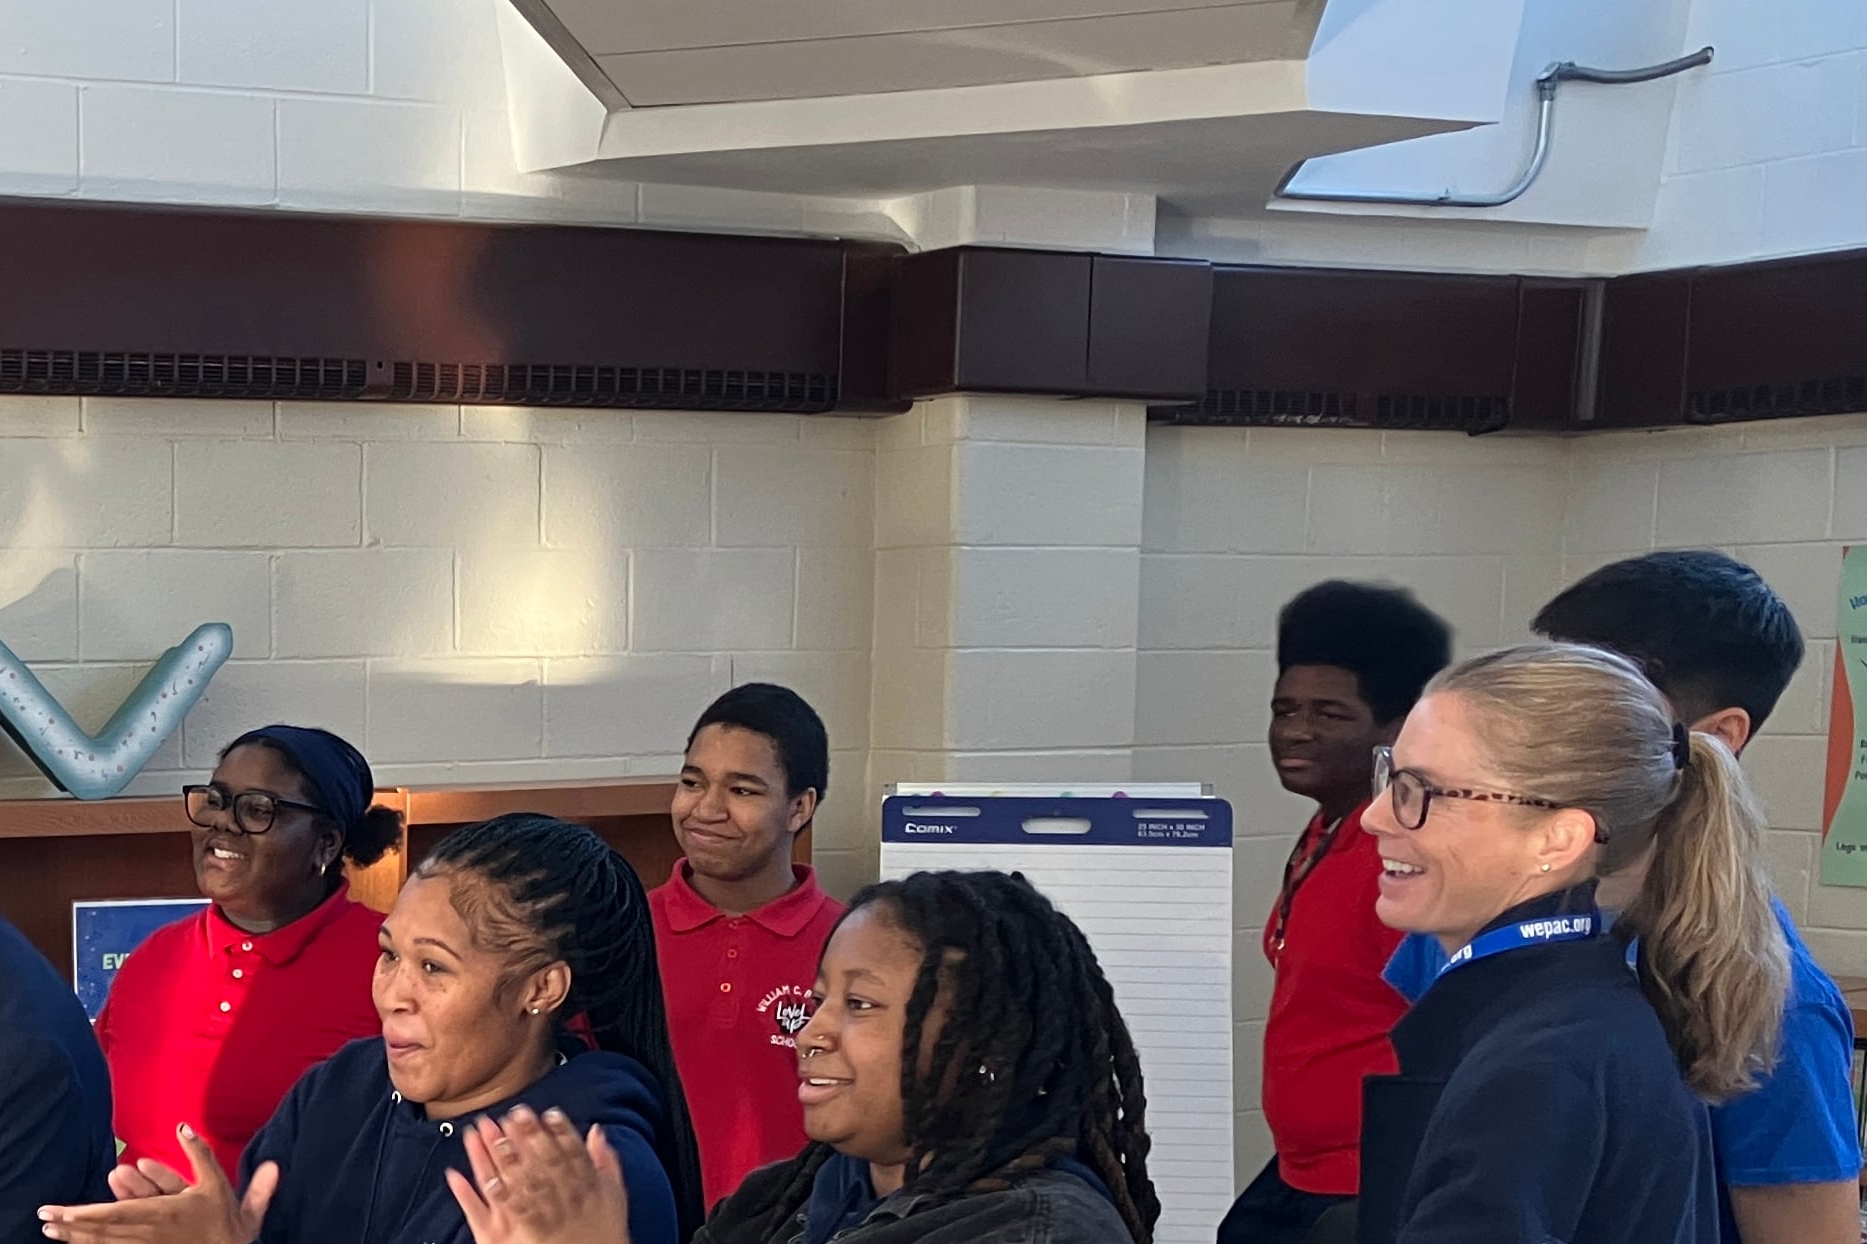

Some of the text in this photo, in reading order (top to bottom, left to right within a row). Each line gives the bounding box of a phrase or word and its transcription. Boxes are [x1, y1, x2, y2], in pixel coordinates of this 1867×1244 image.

[905, 822, 954, 834] Comix
[1519, 916, 1592, 939] wepac.org
[756, 984, 791, 1013] WILLIAM
